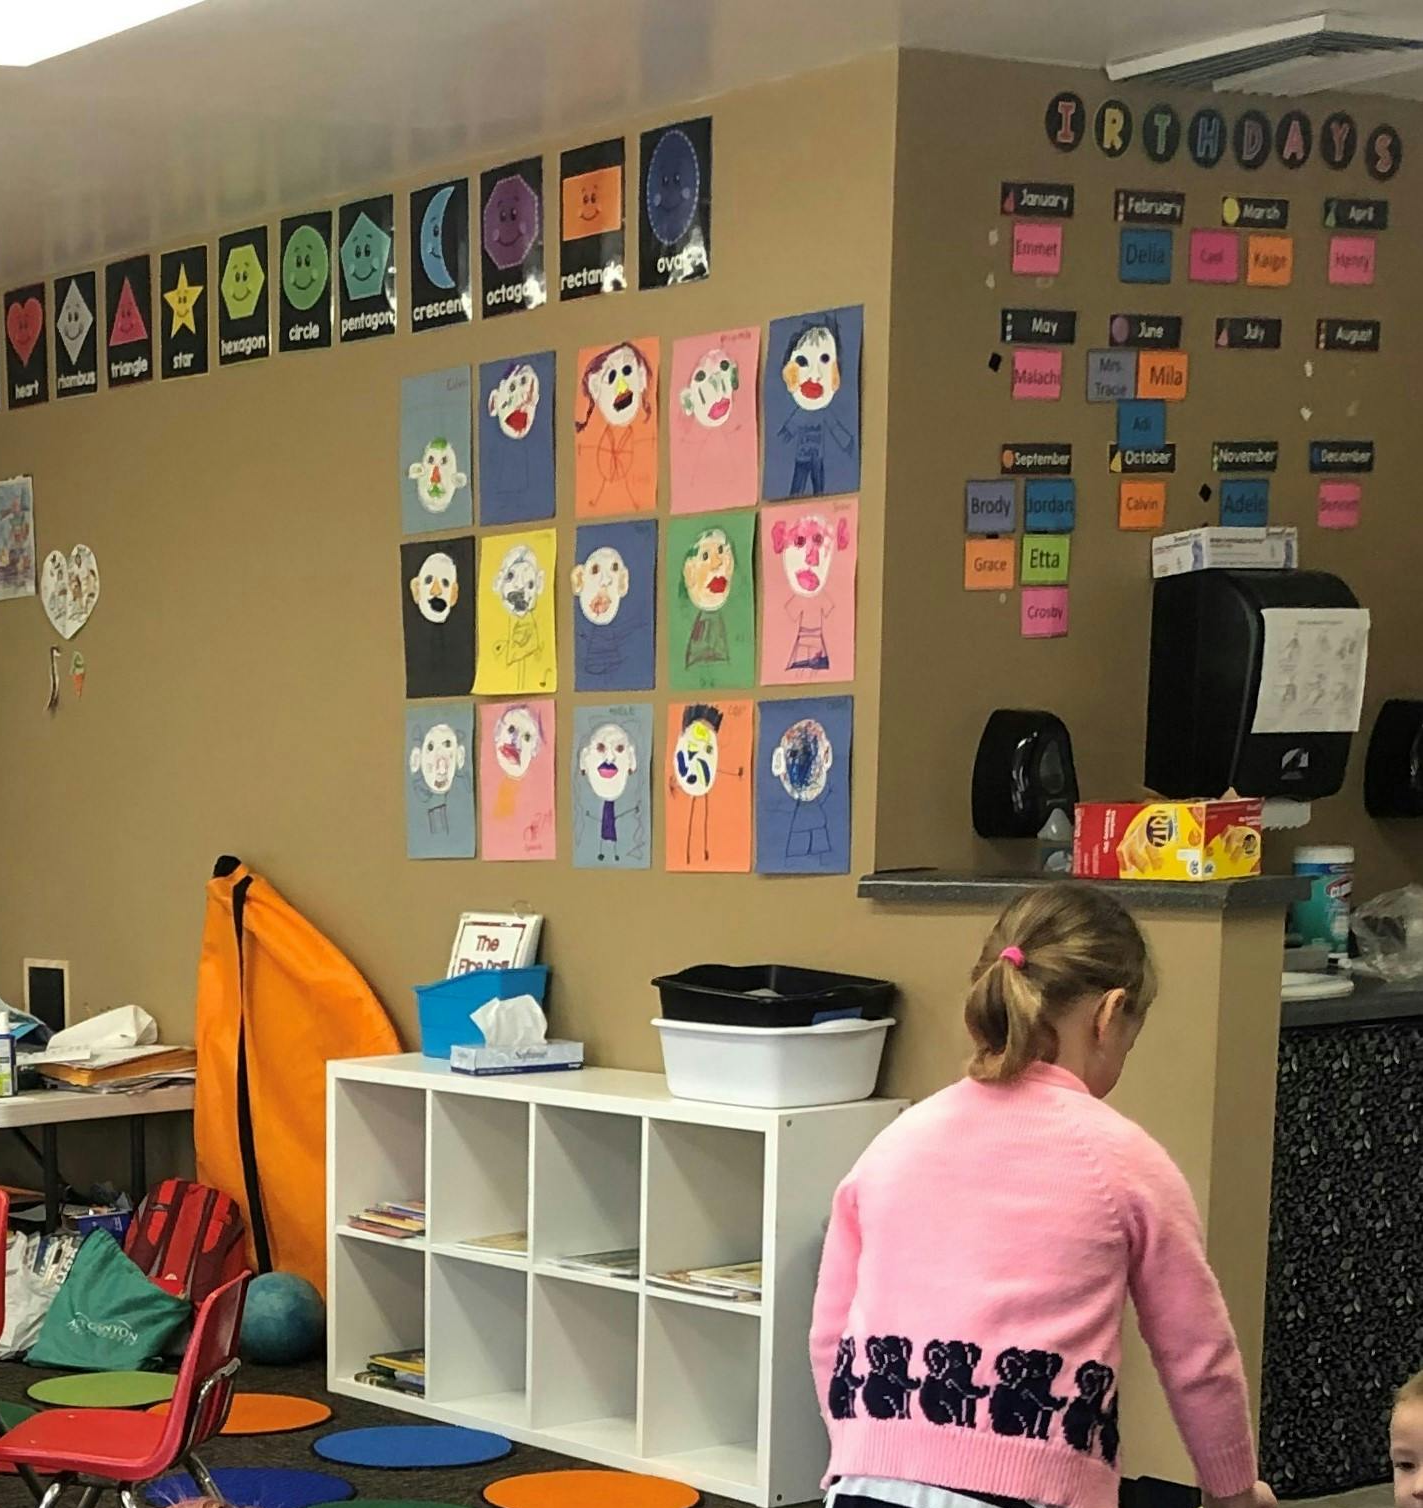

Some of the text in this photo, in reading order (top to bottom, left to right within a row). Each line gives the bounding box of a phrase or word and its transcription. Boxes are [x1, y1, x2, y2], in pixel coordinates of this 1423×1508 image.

[1021, 188, 1068, 211] January
[1127, 196, 1181, 217] February
[413, 296, 467, 322] crescen
[289, 321, 321, 342] circle
[1031, 317, 1059, 337] May
[1137, 321, 1164, 339] June
[221, 334, 267, 357] hexagon
[110, 355, 149, 379] triangle
[172, 351, 195, 370] star
[57, 369, 96, 390] rhombus
[1150, 366, 1183, 386] Mila
[15, 379, 40, 401] heart
[1014, 451, 1070, 466] September
[1124, 450, 1173, 466] October
[1218, 449, 1277, 464] November
[1321, 449, 1371, 464] December
[971, 498, 1012, 516] Brody
[1125, 496, 1159, 512] Calvin
[973, 556, 1008, 572] Grace
[1030, 548, 1060, 569] Etta
[1027, 605, 1064, 620] Crosby
[475, 934, 500, 952] The
